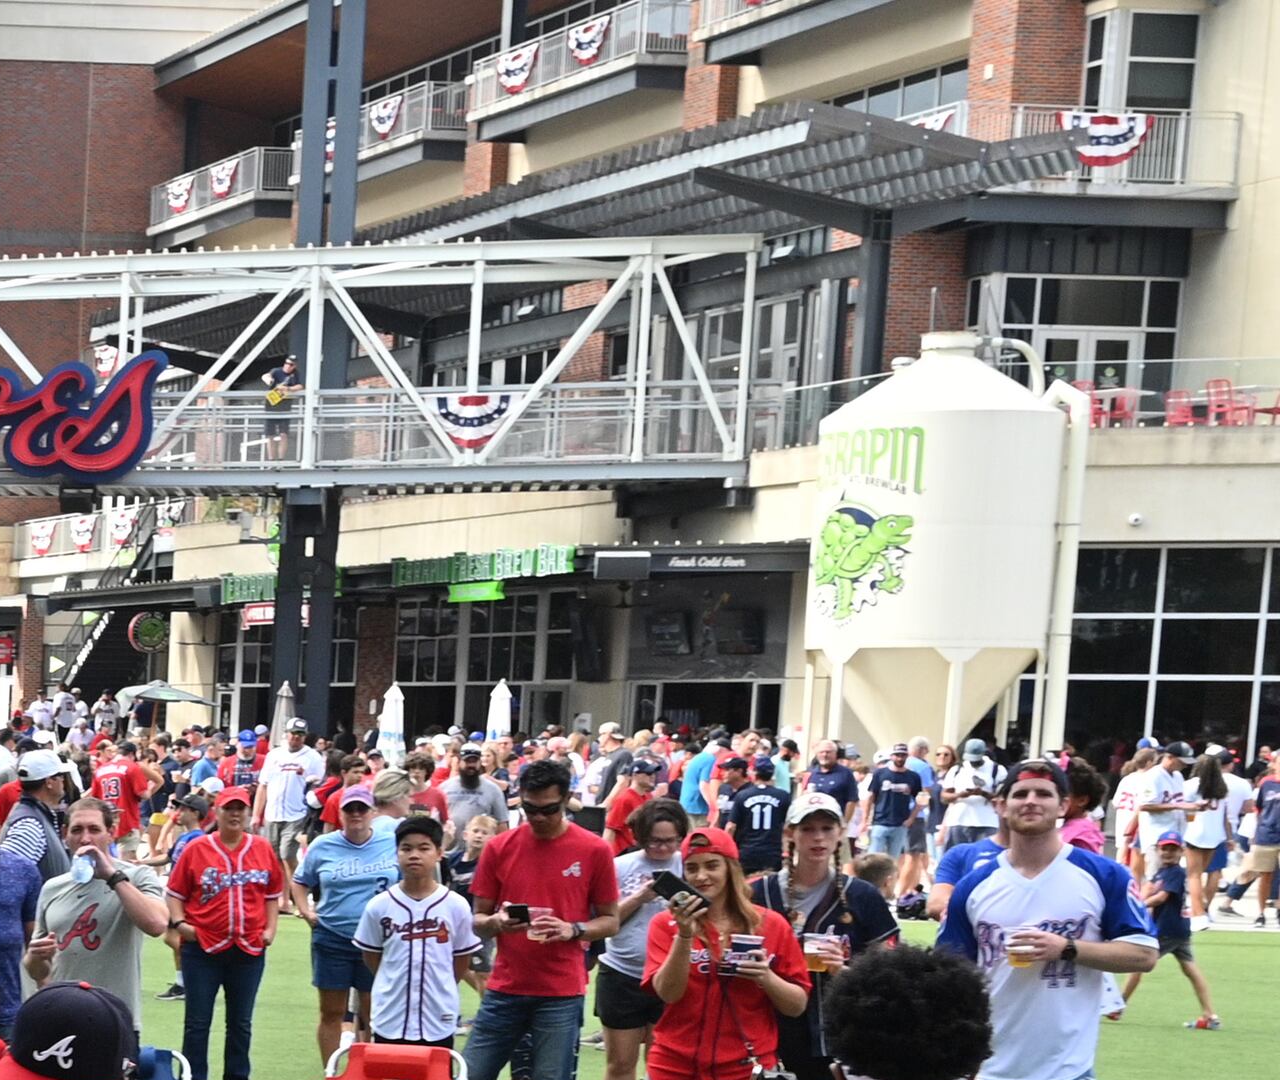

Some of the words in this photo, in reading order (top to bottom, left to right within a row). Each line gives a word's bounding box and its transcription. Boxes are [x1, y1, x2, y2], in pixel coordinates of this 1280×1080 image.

[494, 549, 535, 580] BREW
[536, 545, 576, 577] BAR
[668, 557, 697, 568] Fresh
[697, 556, 721, 568] Cold
[101, 778, 121, 799] 13
[750, 804, 774, 830] 11
[380, 916, 439, 940] Braves
[1041, 960, 1078, 989] 44
[33, 1034, 76, 1069] A
